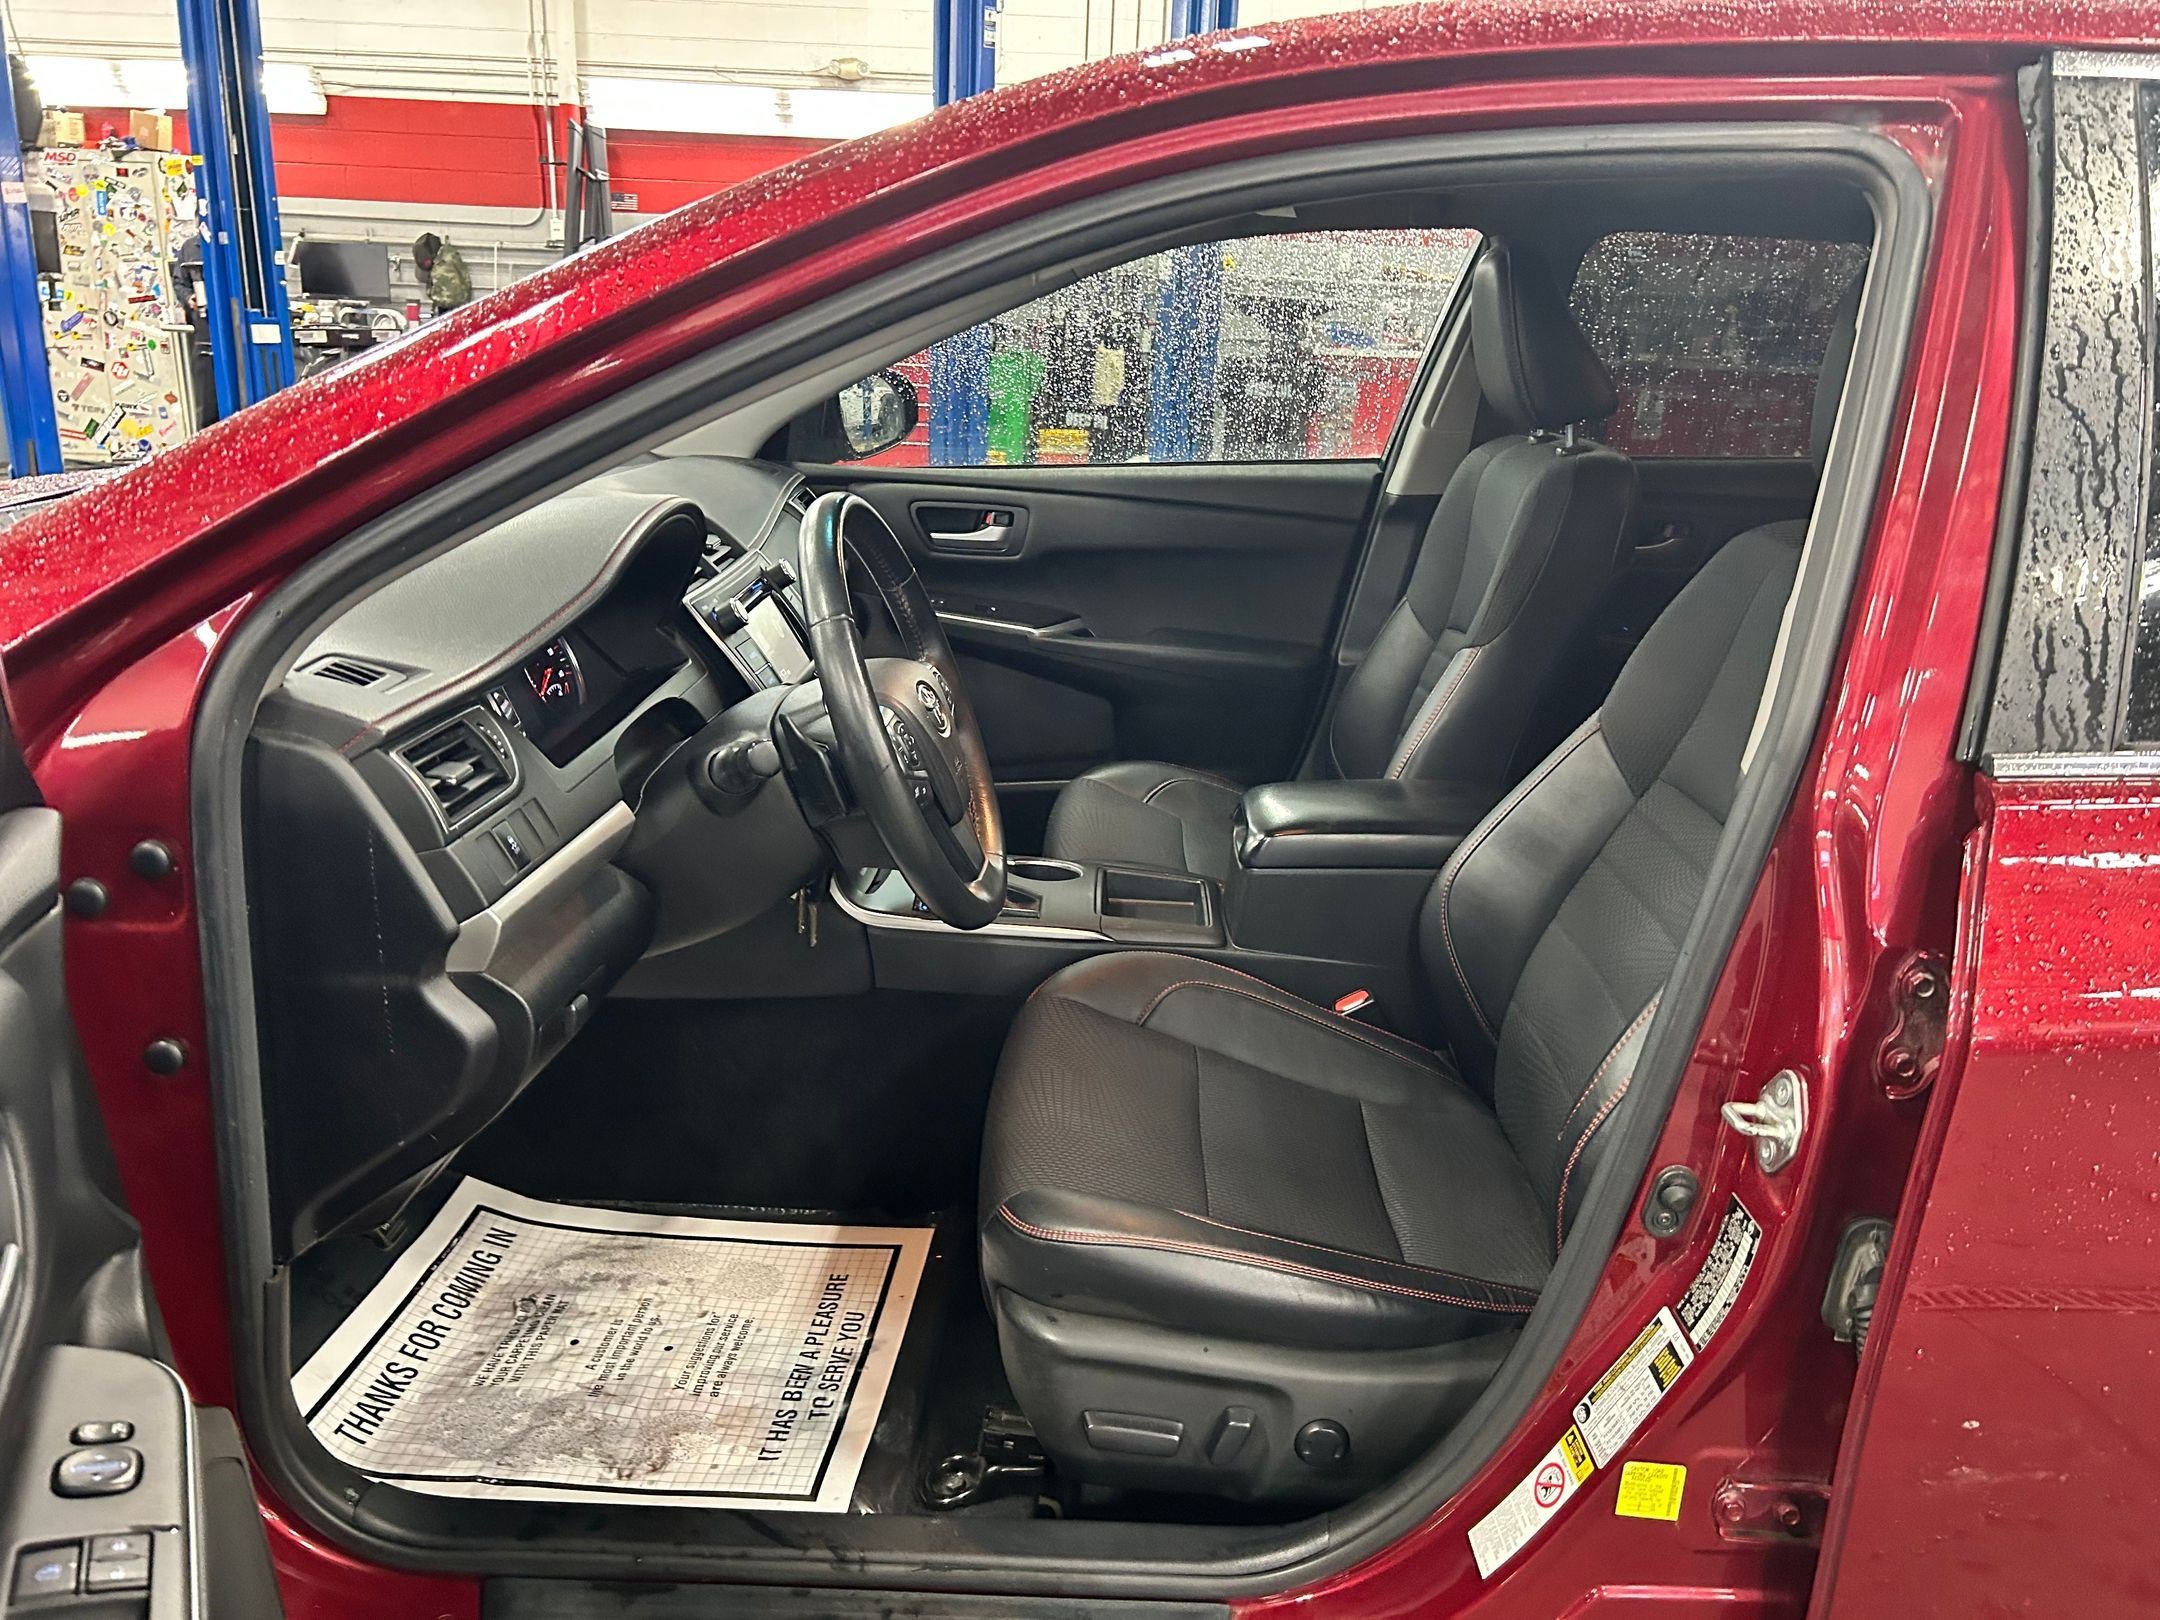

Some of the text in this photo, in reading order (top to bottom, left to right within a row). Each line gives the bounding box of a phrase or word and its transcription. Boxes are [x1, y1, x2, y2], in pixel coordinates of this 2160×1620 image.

[44, 151, 76, 162] MSD
[334, 1227, 518, 1444] THANKS FOR COMING IN
[472, 1373, 490, 1387] WE
[482, 1352, 504, 1373] HAVE
[513, 1315, 529, 1328] TO
[507, 1300, 570, 1383] WITH THIS PAPER MAT
[587, 1297, 655, 1398] the most important person
[591, 1329, 618, 1363] customer
[613, 1372, 625, 1381] in
[620, 1357, 636, 1371] the
[628, 1335, 649, 1357] world
[641, 1326, 654, 1337] to
[672, 1369, 692, 1391] Your
[686, 1325, 715, 1368] suggestions
[689, 1313, 740, 1397] improving our service
[757, 1273, 850, 1461] IT HAS BEEN A PLEASURE
[808, 1311, 865, 1420] TO SERVE YOU
[489, 1366, 512, 1387] YOUR
[708, 1379, 724, 1398] are
[716, 1354, 738, 1381] always
